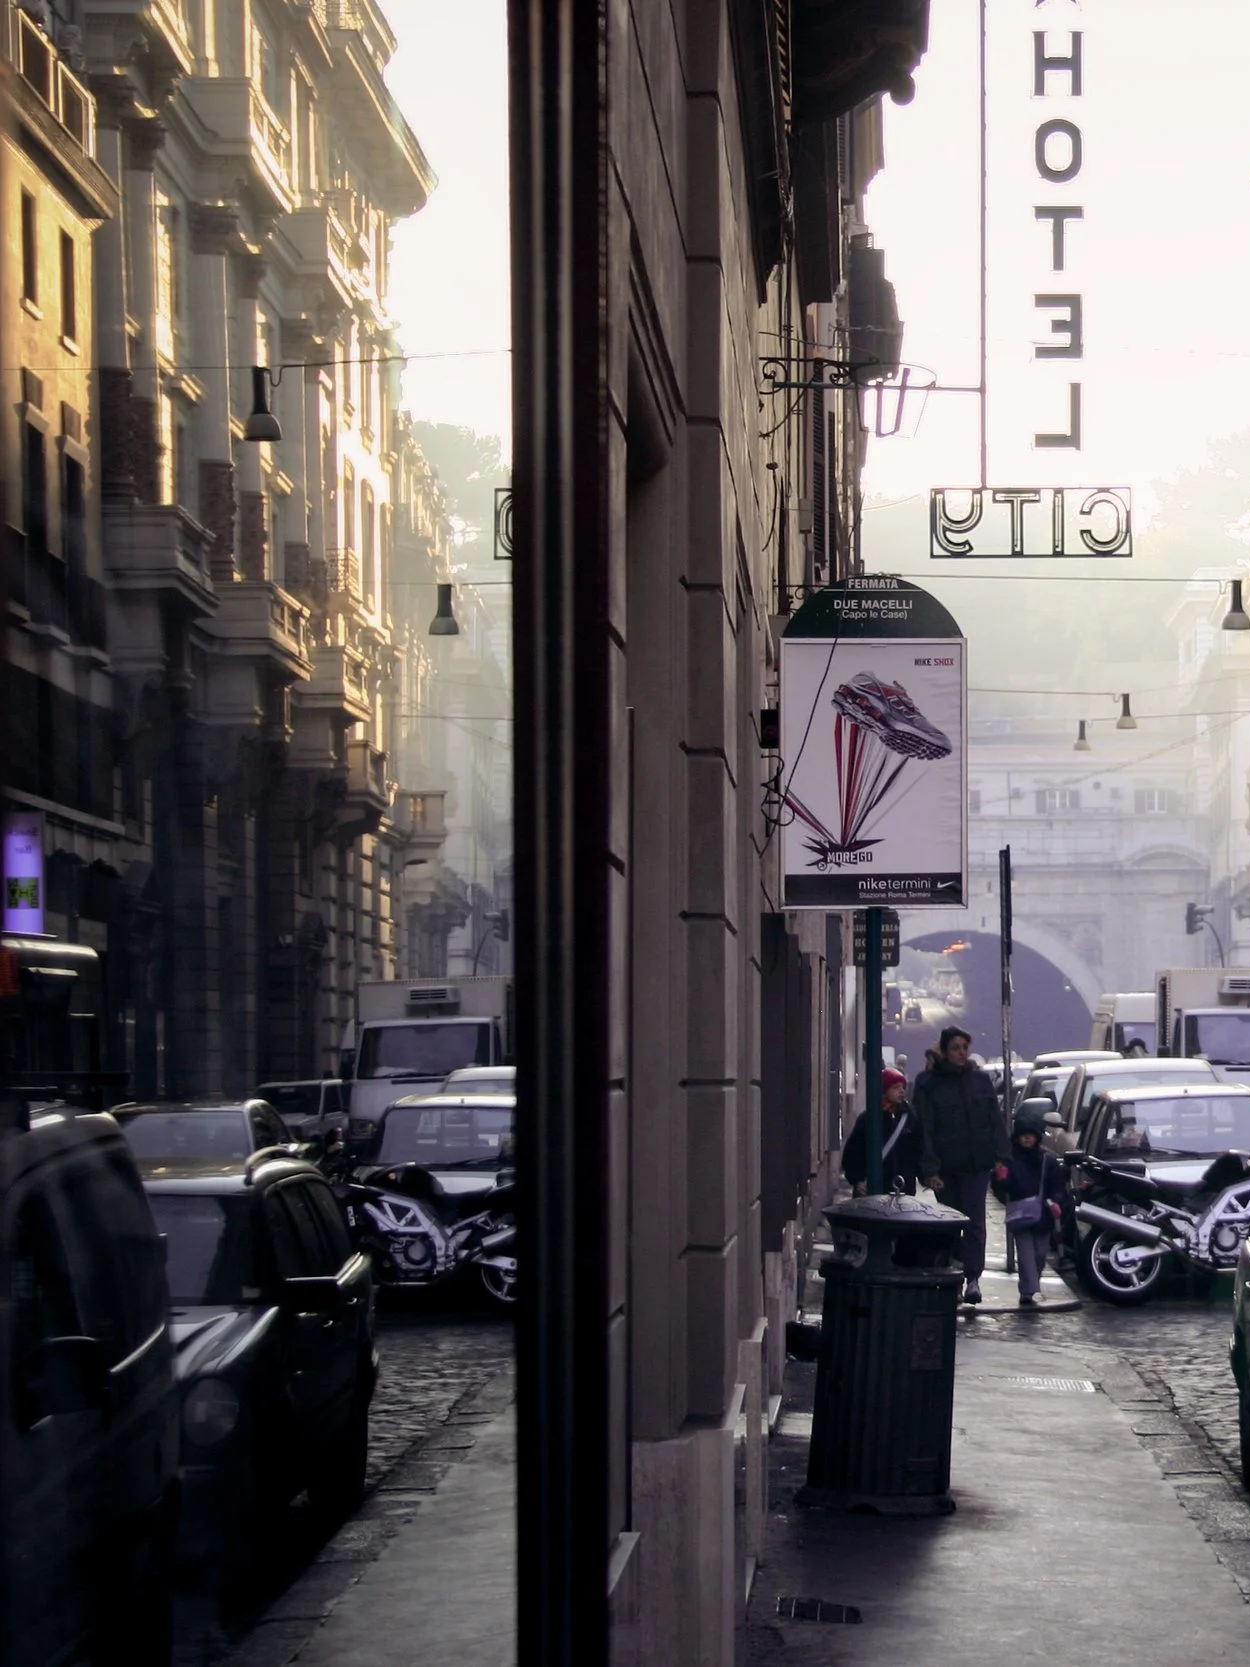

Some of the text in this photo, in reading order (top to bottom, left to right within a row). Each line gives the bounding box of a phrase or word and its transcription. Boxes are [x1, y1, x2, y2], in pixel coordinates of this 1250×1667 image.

[848, 578, 899, 589] FERMATA
[833, 599, 913, 609] DUE MACELLI
[869, 610, 878, 619] le
[880, 610, 908, 620] Case)
[914, 658, 955, 667] NIKE SHOX
[908, 891, 931, 899] Termini
